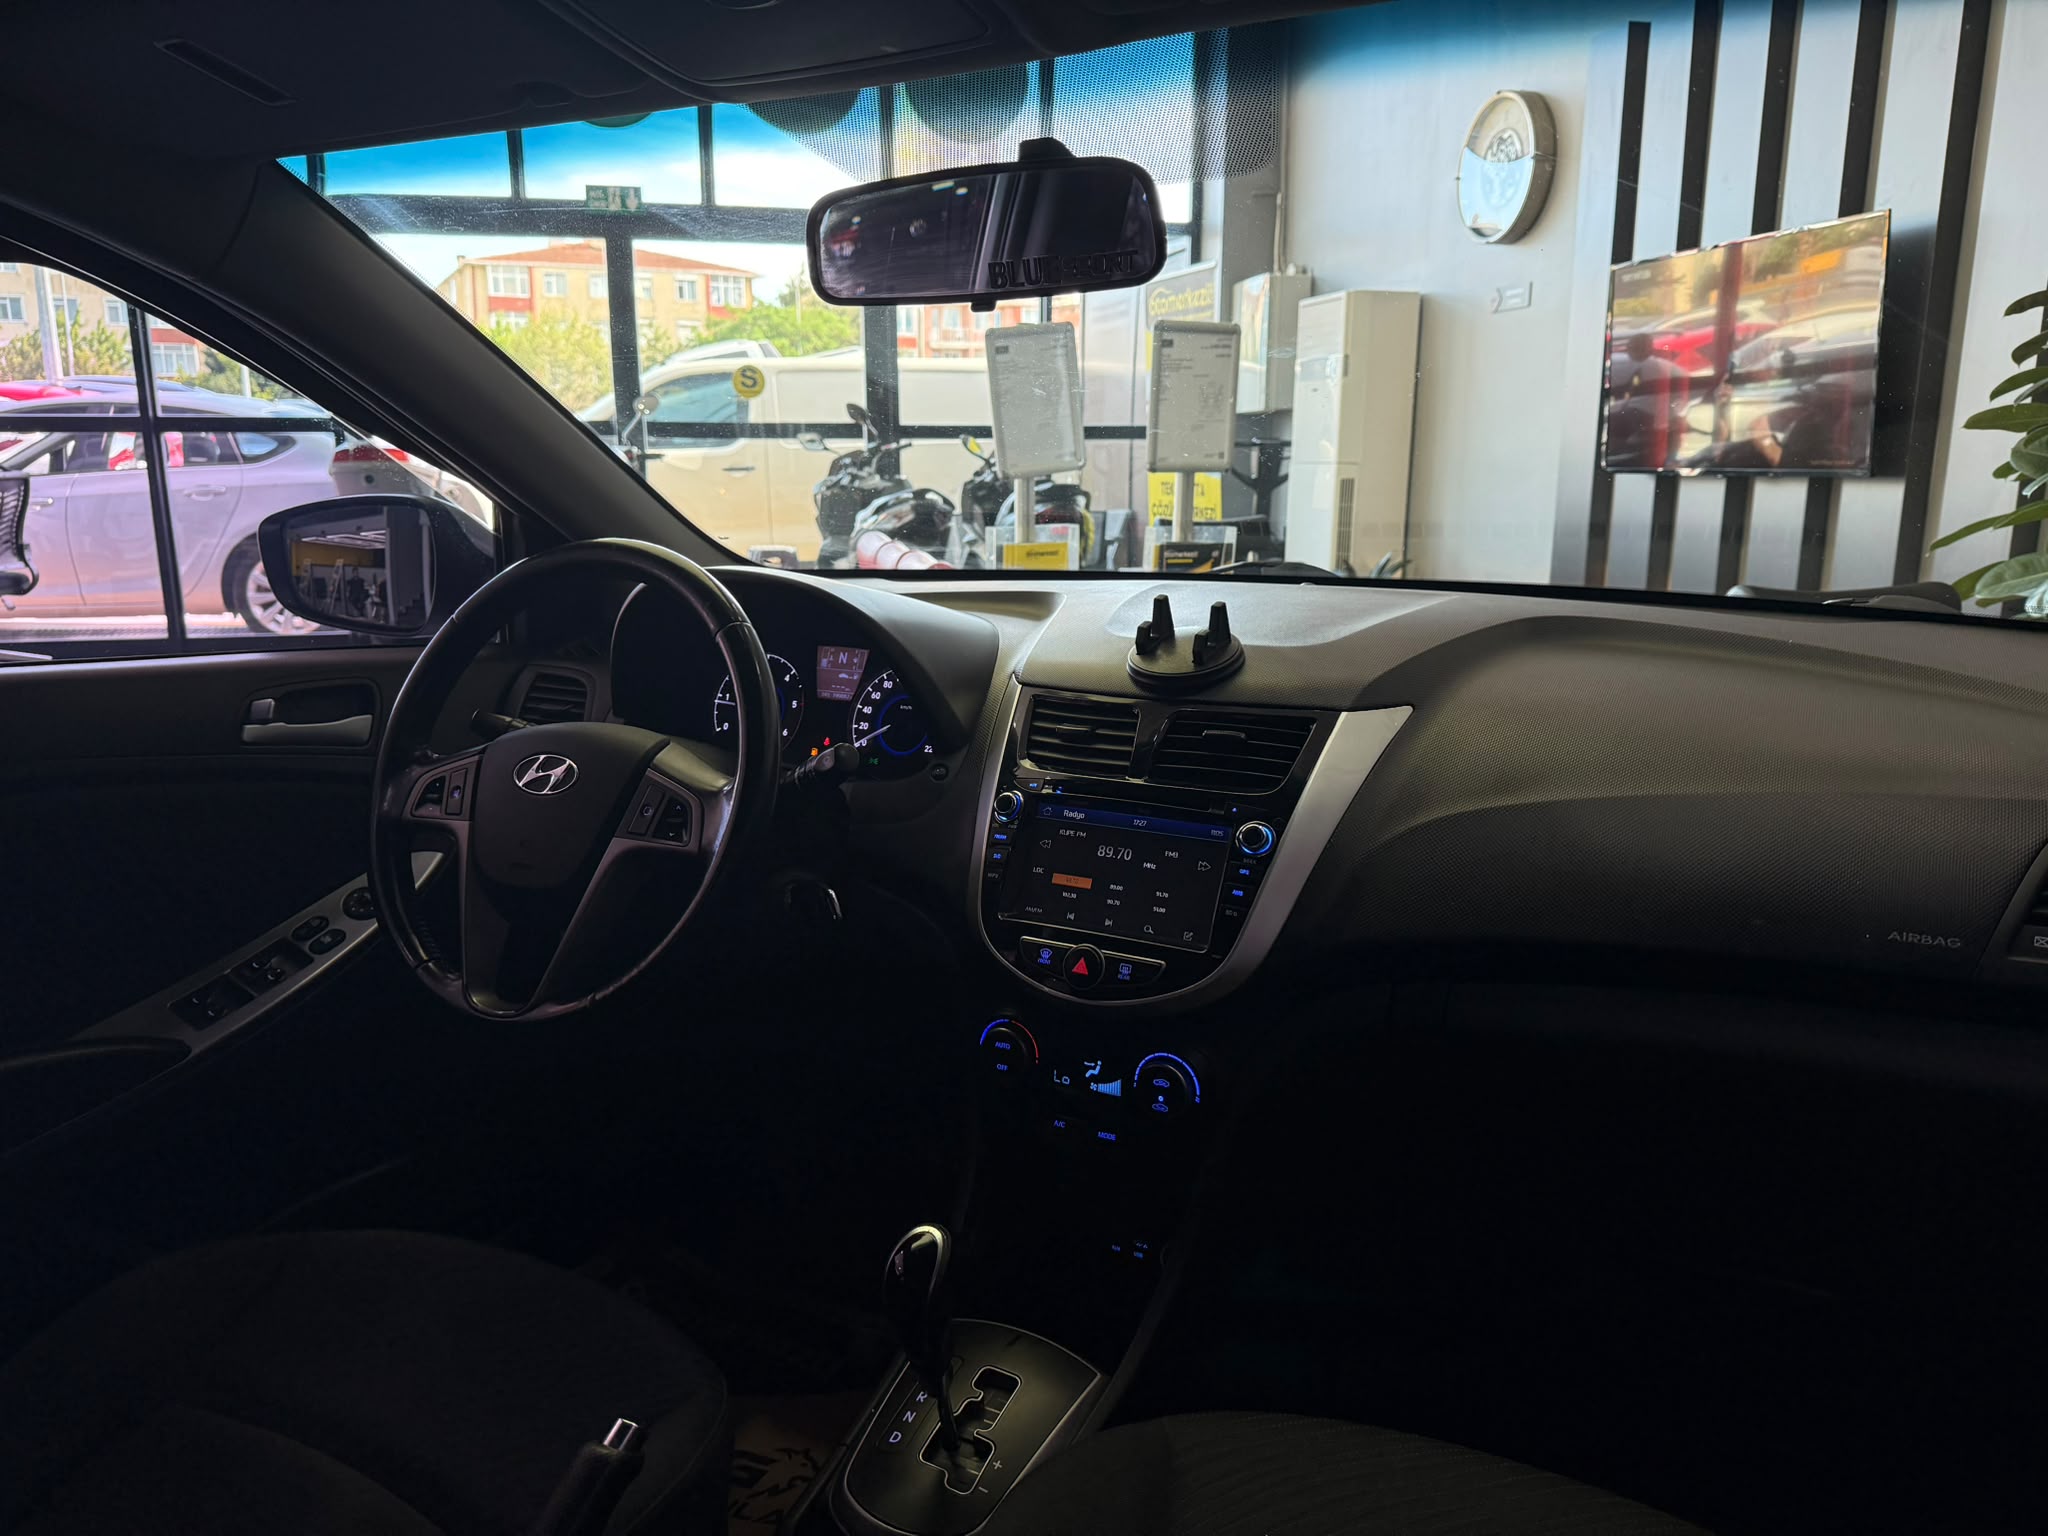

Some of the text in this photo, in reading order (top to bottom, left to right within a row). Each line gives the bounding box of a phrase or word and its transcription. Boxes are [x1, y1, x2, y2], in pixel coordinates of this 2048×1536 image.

[741, 367, 758, 389] S
[838, 651, 848, 664] N
[883, 680, 893, 689] 80
[871, 691, 881, 700] 60
[792, 700, 798, 709] 5
[862, 705, 872, 714] 40
[723, 722, 729, 730] 0
[858, 721, 869, 730] 20
[782, 728, 788, 737] 6
[1063, 809, 1085, 820] Radyo
[1097, 845, 1133, 861] 89.70
[1887, 931, 1961, 949] AIRBAG
[994, 1041, 1012, 1051] AUTO
[996, 1063, 1009, 1072] OFF
[1053, 1119, 1067, 1129] A/C
[1097, 1131, 1117, 1142] MODE
[915, 1391, 928, 1403] R
[902, 1410, 917, 1424] N
[888, 1431, 902, 1444] D
